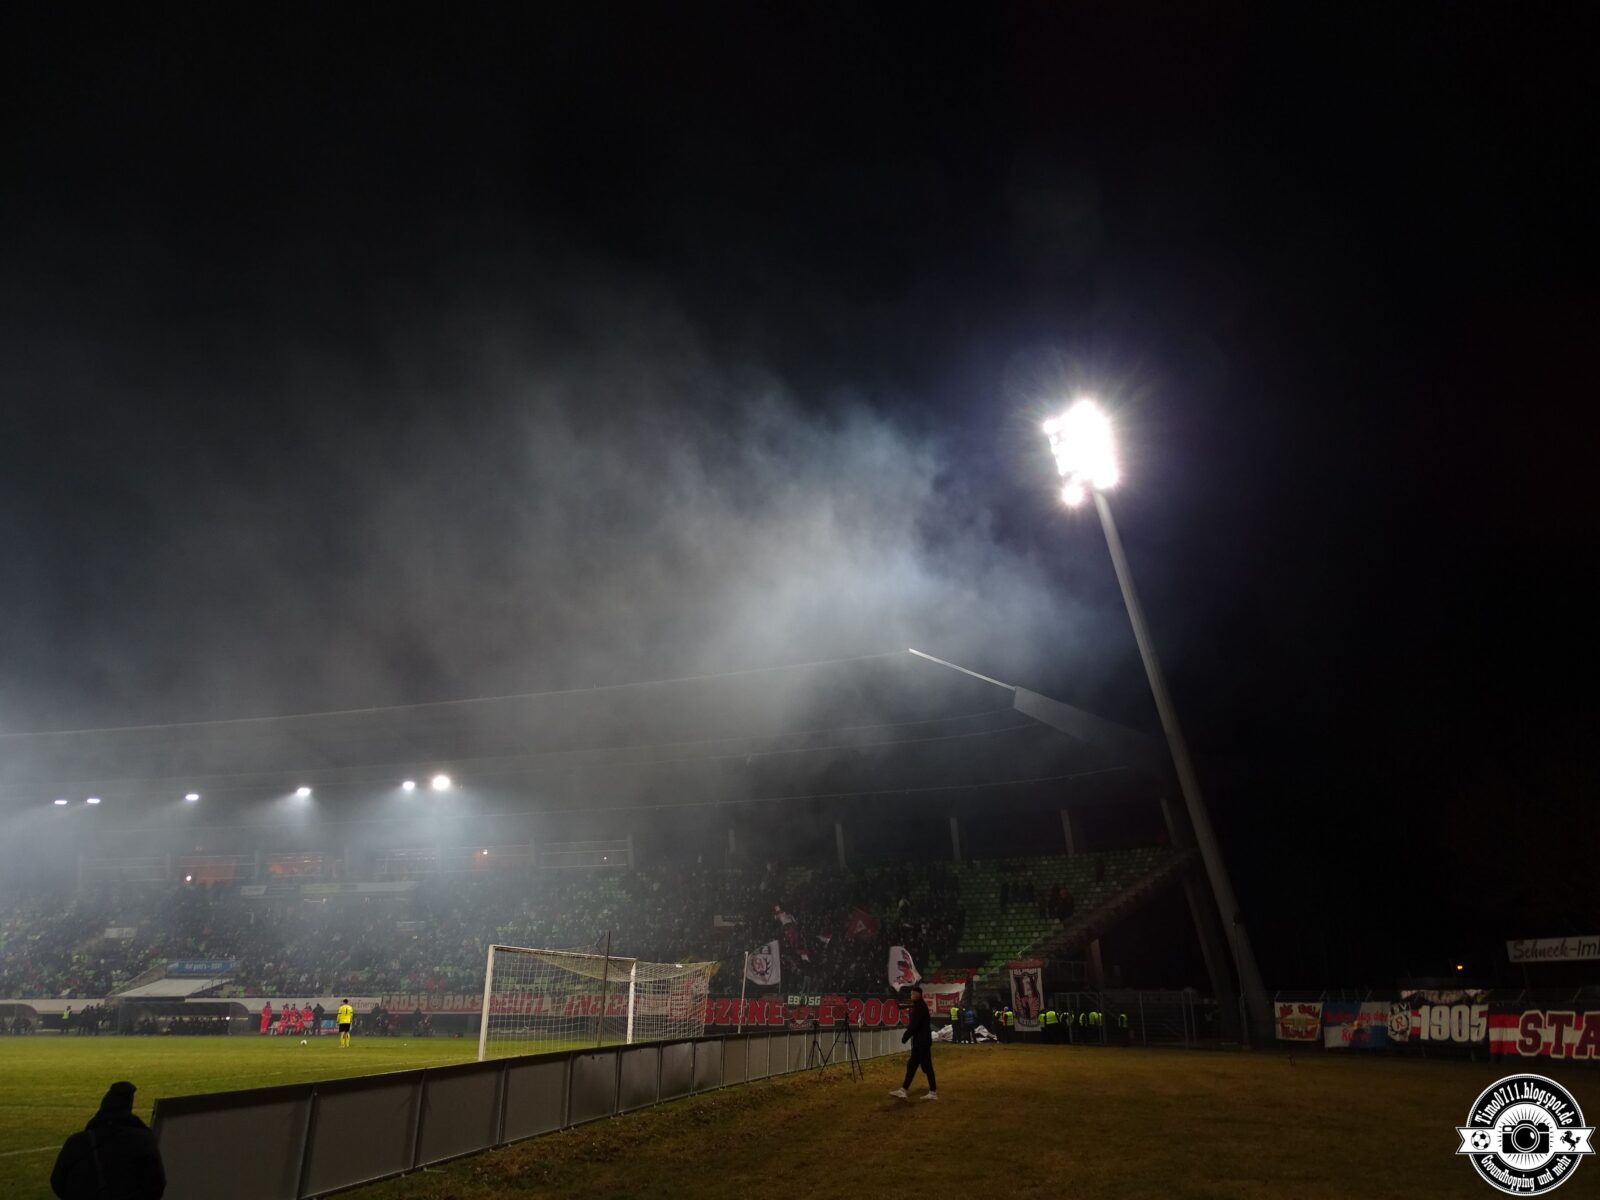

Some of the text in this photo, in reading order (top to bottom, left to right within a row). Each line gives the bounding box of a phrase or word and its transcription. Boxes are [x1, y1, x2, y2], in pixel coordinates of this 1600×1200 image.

[1512, 936, 1600, 960] Schneck-Im
[1418, 1003, 1489, 1043] 1905
[1516, 1009, 1600, 1059] STA
